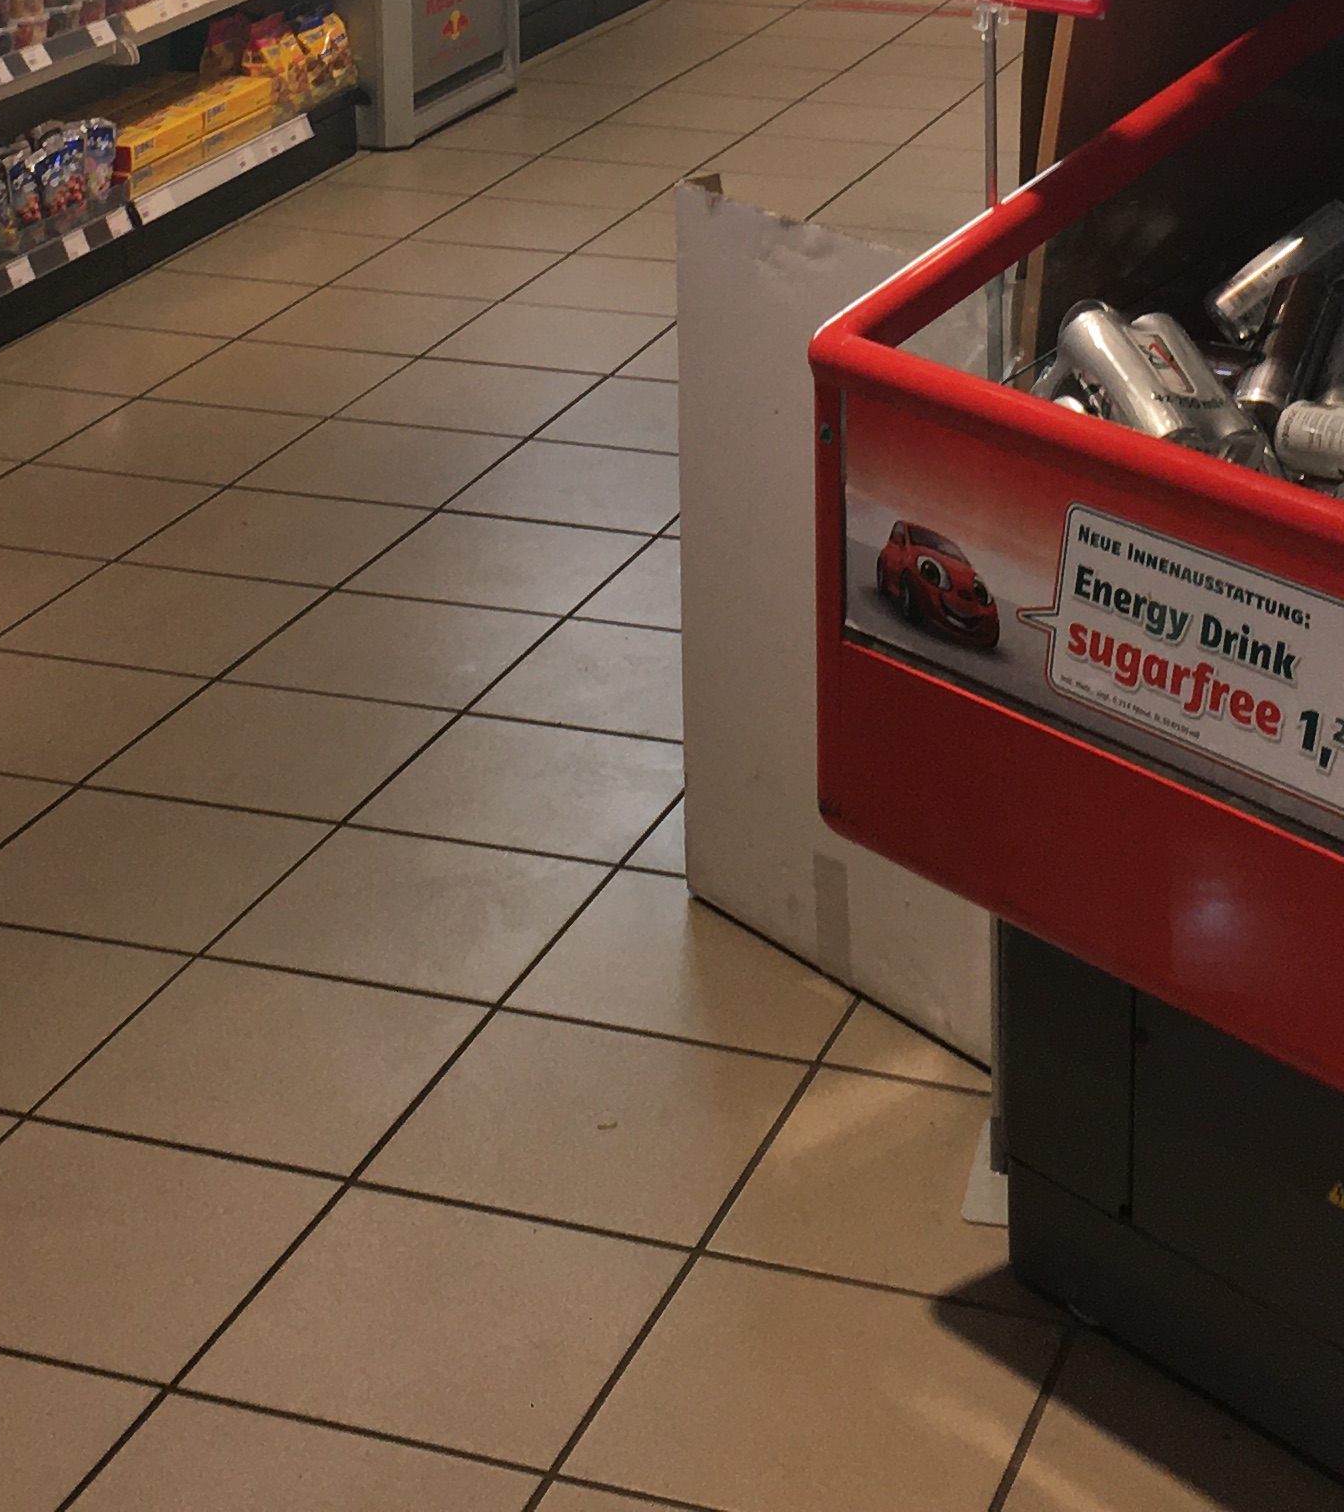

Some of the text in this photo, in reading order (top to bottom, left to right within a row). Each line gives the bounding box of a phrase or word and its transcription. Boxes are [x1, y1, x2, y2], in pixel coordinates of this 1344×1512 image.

[1066, 622, 1283, 737] sugarfree
[1073, 564, 1297, 681] Energy Drink
